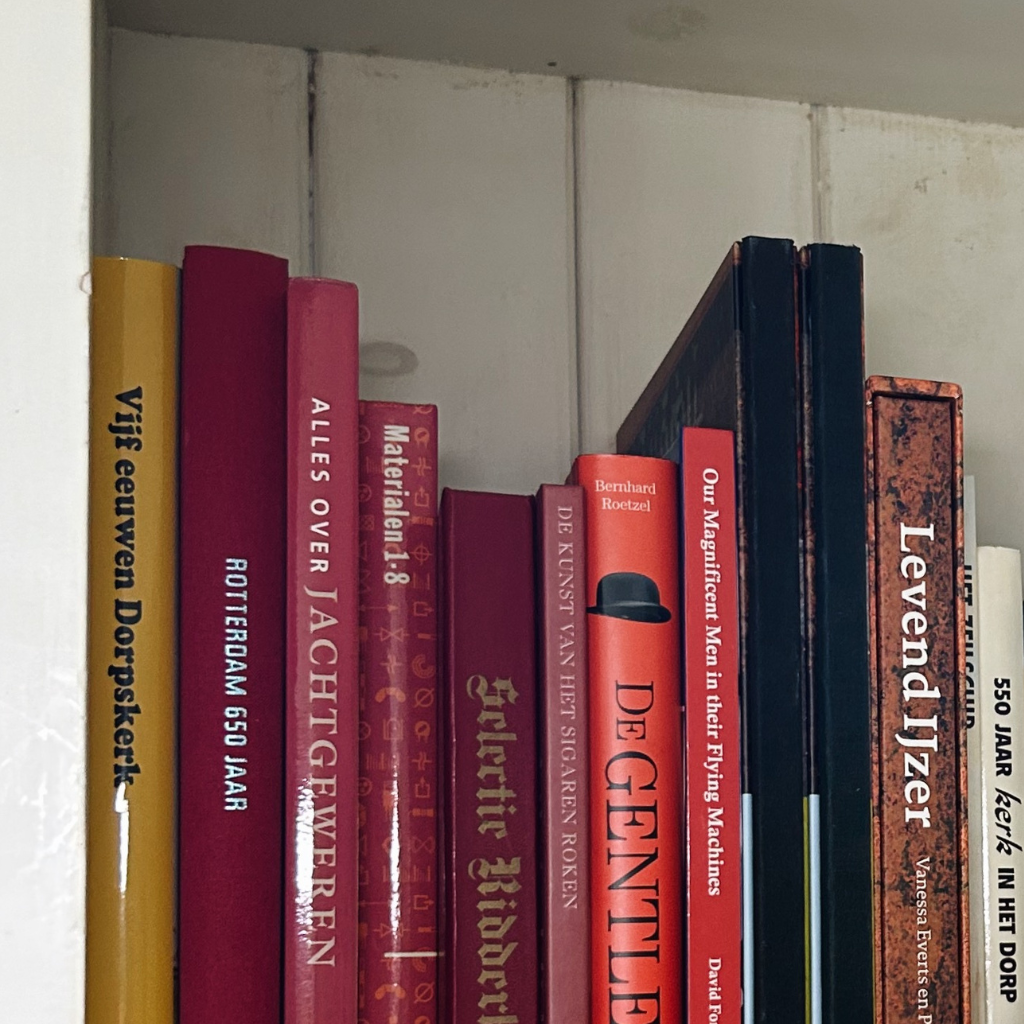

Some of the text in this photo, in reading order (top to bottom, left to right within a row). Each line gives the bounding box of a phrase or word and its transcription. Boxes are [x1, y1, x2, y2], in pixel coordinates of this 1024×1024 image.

[383, 424, 410, 544] Materialen
[594, 479, 657, 496] Bernhard
[601, 497, 652, 513] Roetzel
[108, 386, 143, 789] Vijf eeuwen Dorpskerk
[895, 523, 942, 829] Levend IJzer
[224, 557, 248, 812] ROTTERDAM 650 JAAR
[303, 397, 339, 967] ALLES OVER JACHTGEWEREN
[558, 505, 578, 909] DE KUNST VAN HET SIGAREN ROKEN
[700, 467, 724, 897] Our Magnificent Men in their Flying Machines
[916, 857, 931, 926] Vanessa
[993, 677, 1023, 1004] 550 JAAR kerk IN HET DORP
[708, 957, 721, 1001] David
[916, 930, 932, 984] Everts
[917, 988, 929, 1010] en
